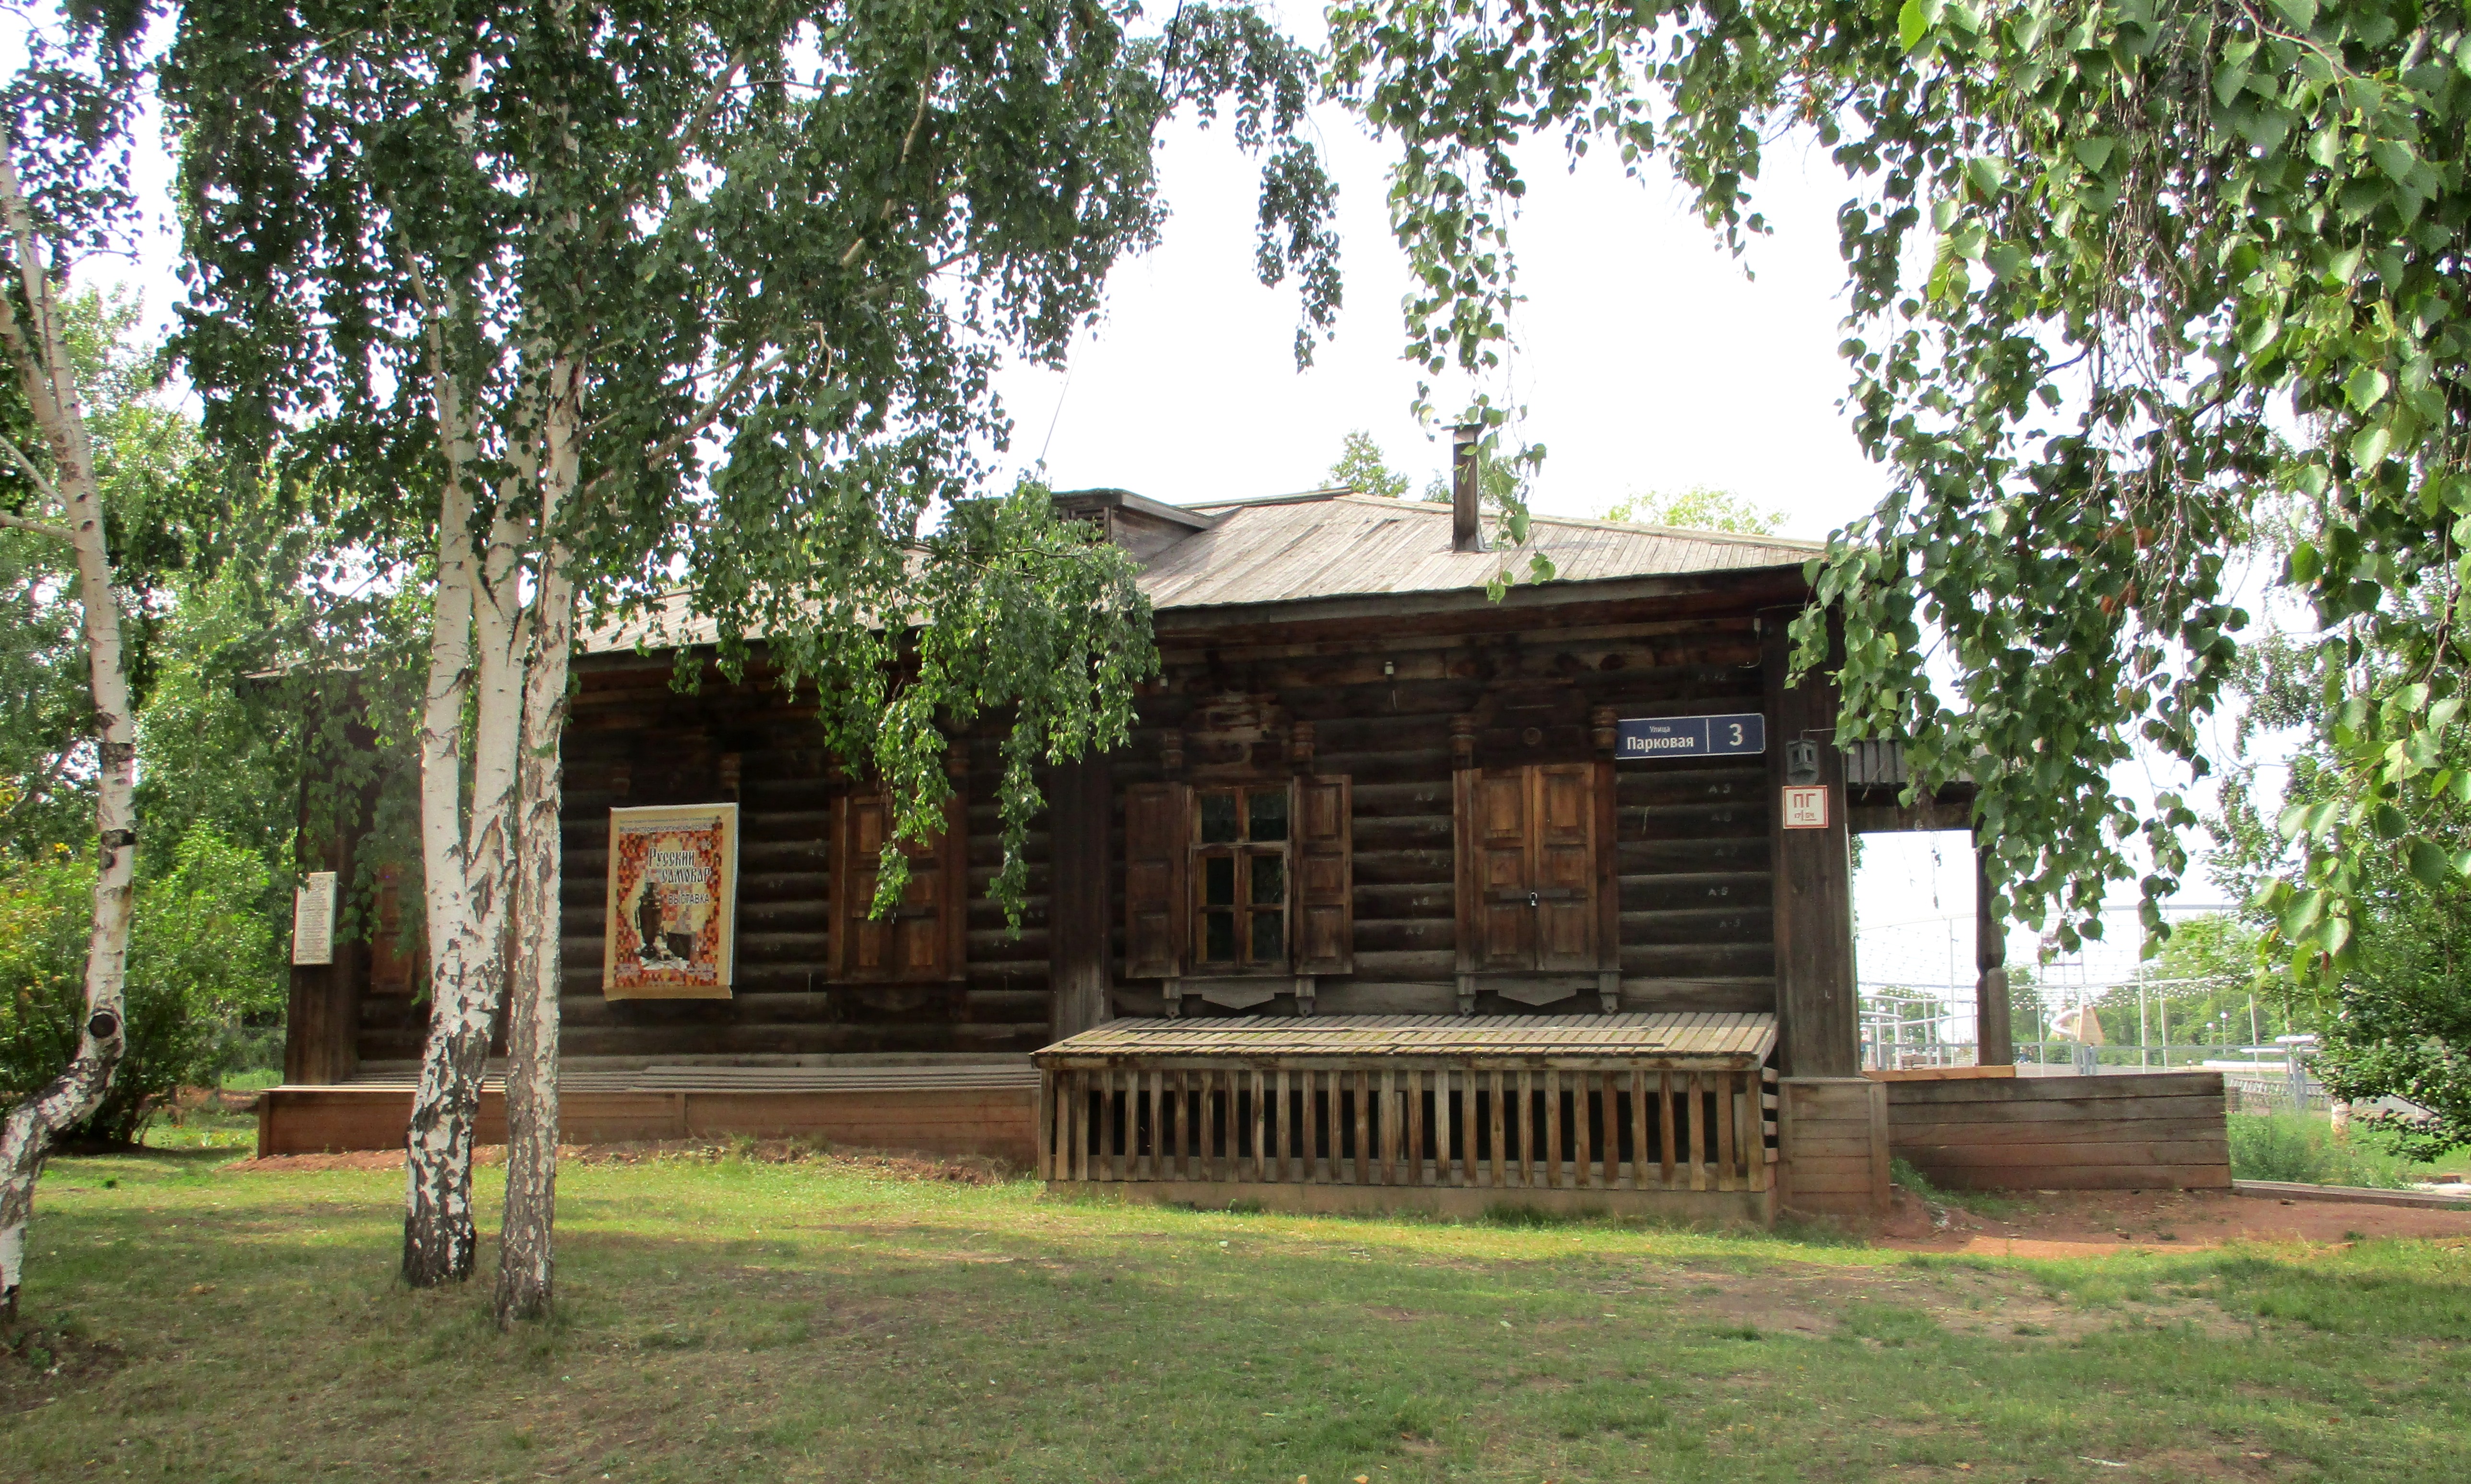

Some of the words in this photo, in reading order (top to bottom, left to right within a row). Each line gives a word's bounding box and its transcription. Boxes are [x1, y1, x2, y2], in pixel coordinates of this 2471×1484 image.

[1729, 723, 1743, 746] 3
[1627, 736, 1694, 753] Парковая
[1794, 793, 1816, 808] ПГ
[649, 848, 695, 867] Русский
[669, 894, 709, 905] ВЫСТАВКА
